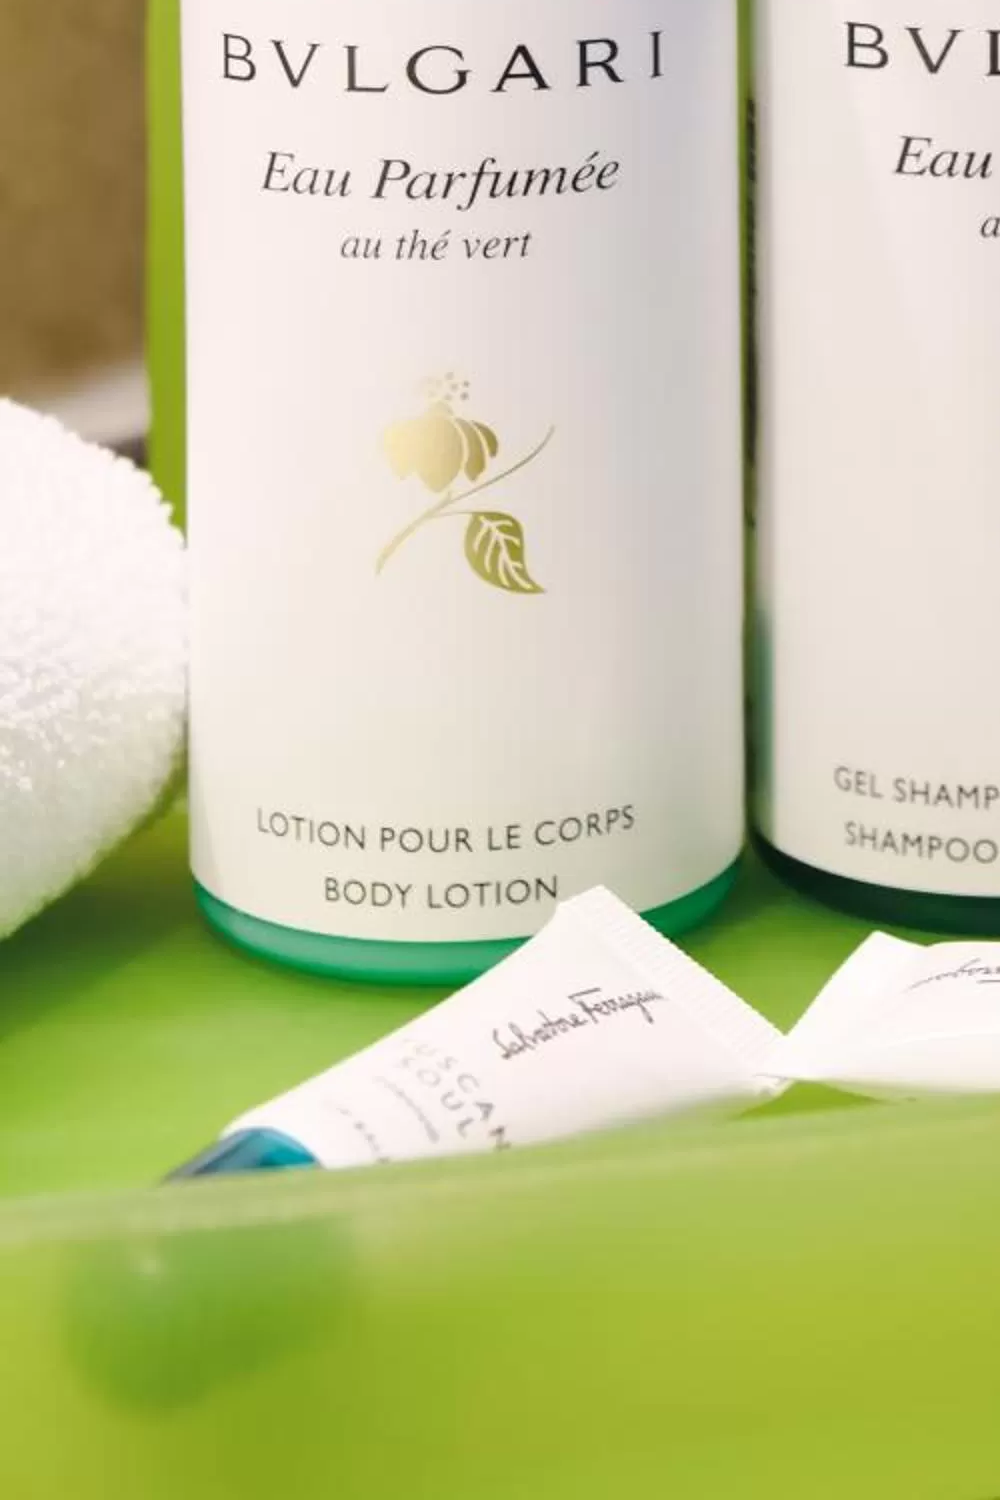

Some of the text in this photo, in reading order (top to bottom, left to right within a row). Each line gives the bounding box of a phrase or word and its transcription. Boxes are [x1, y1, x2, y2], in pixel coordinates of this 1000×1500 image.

[221, 30, 666, 96] BVLGARI
[893, 135, 993, 180] Eau
[260, 150, 620, 211] Eau Parfumée
[339, 228, 533, 261] au thé vert
[833, 766, 884, 799] GEL
[257, 804, 635, 853] LOTION POUR LE CORPS
[844, 821, 999, 864] SHAMPOO
[324, 875, 558, 910] BODY LOTION
